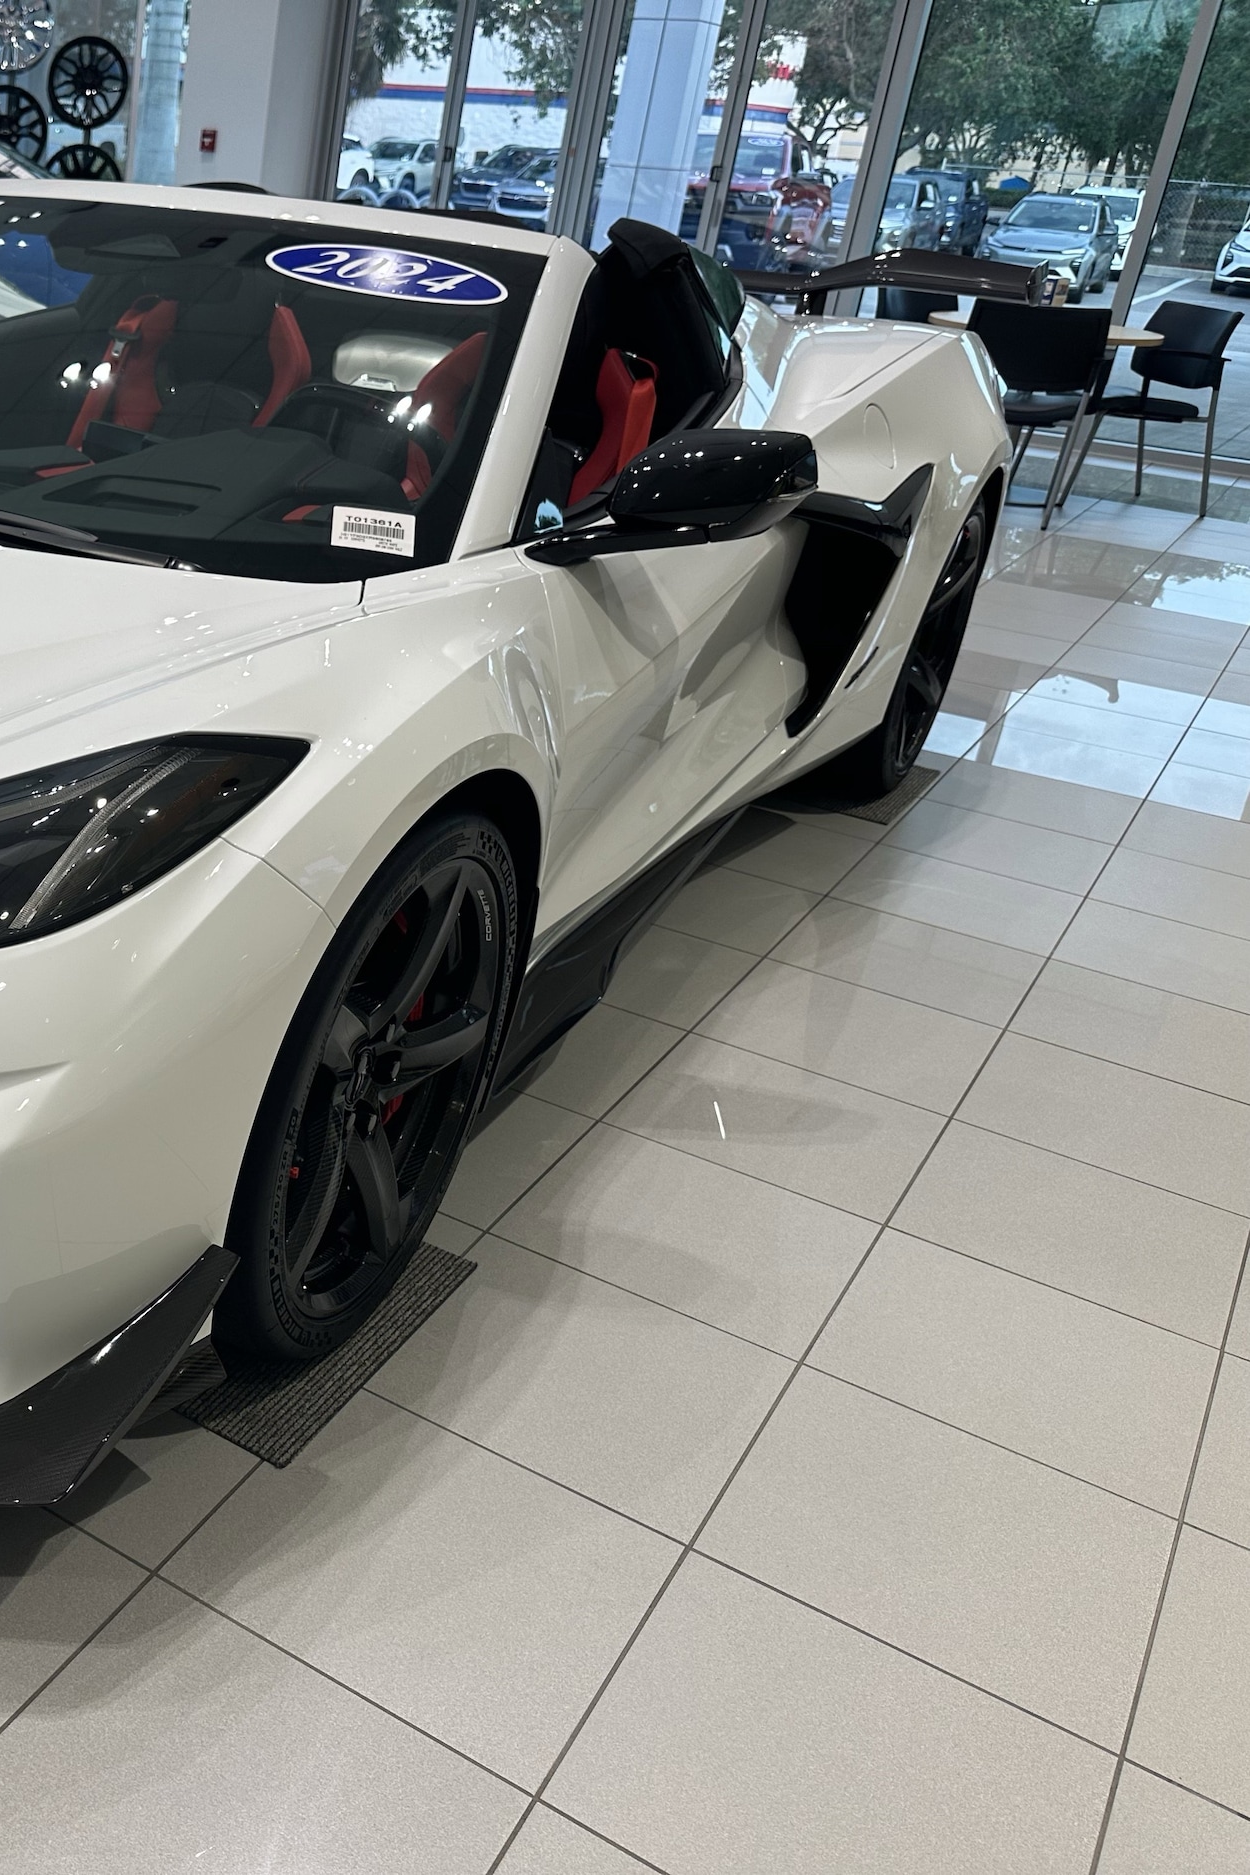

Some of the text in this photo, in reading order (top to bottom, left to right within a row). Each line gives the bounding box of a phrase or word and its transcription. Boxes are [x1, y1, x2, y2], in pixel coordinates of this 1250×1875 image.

[291, 251, 477, 294] 2024
[477, 888, 493, 942] CORVETTE
[499, 861, 518, 931] MICHELIN
[270, 1274, 304, 1346] MICHELIN
